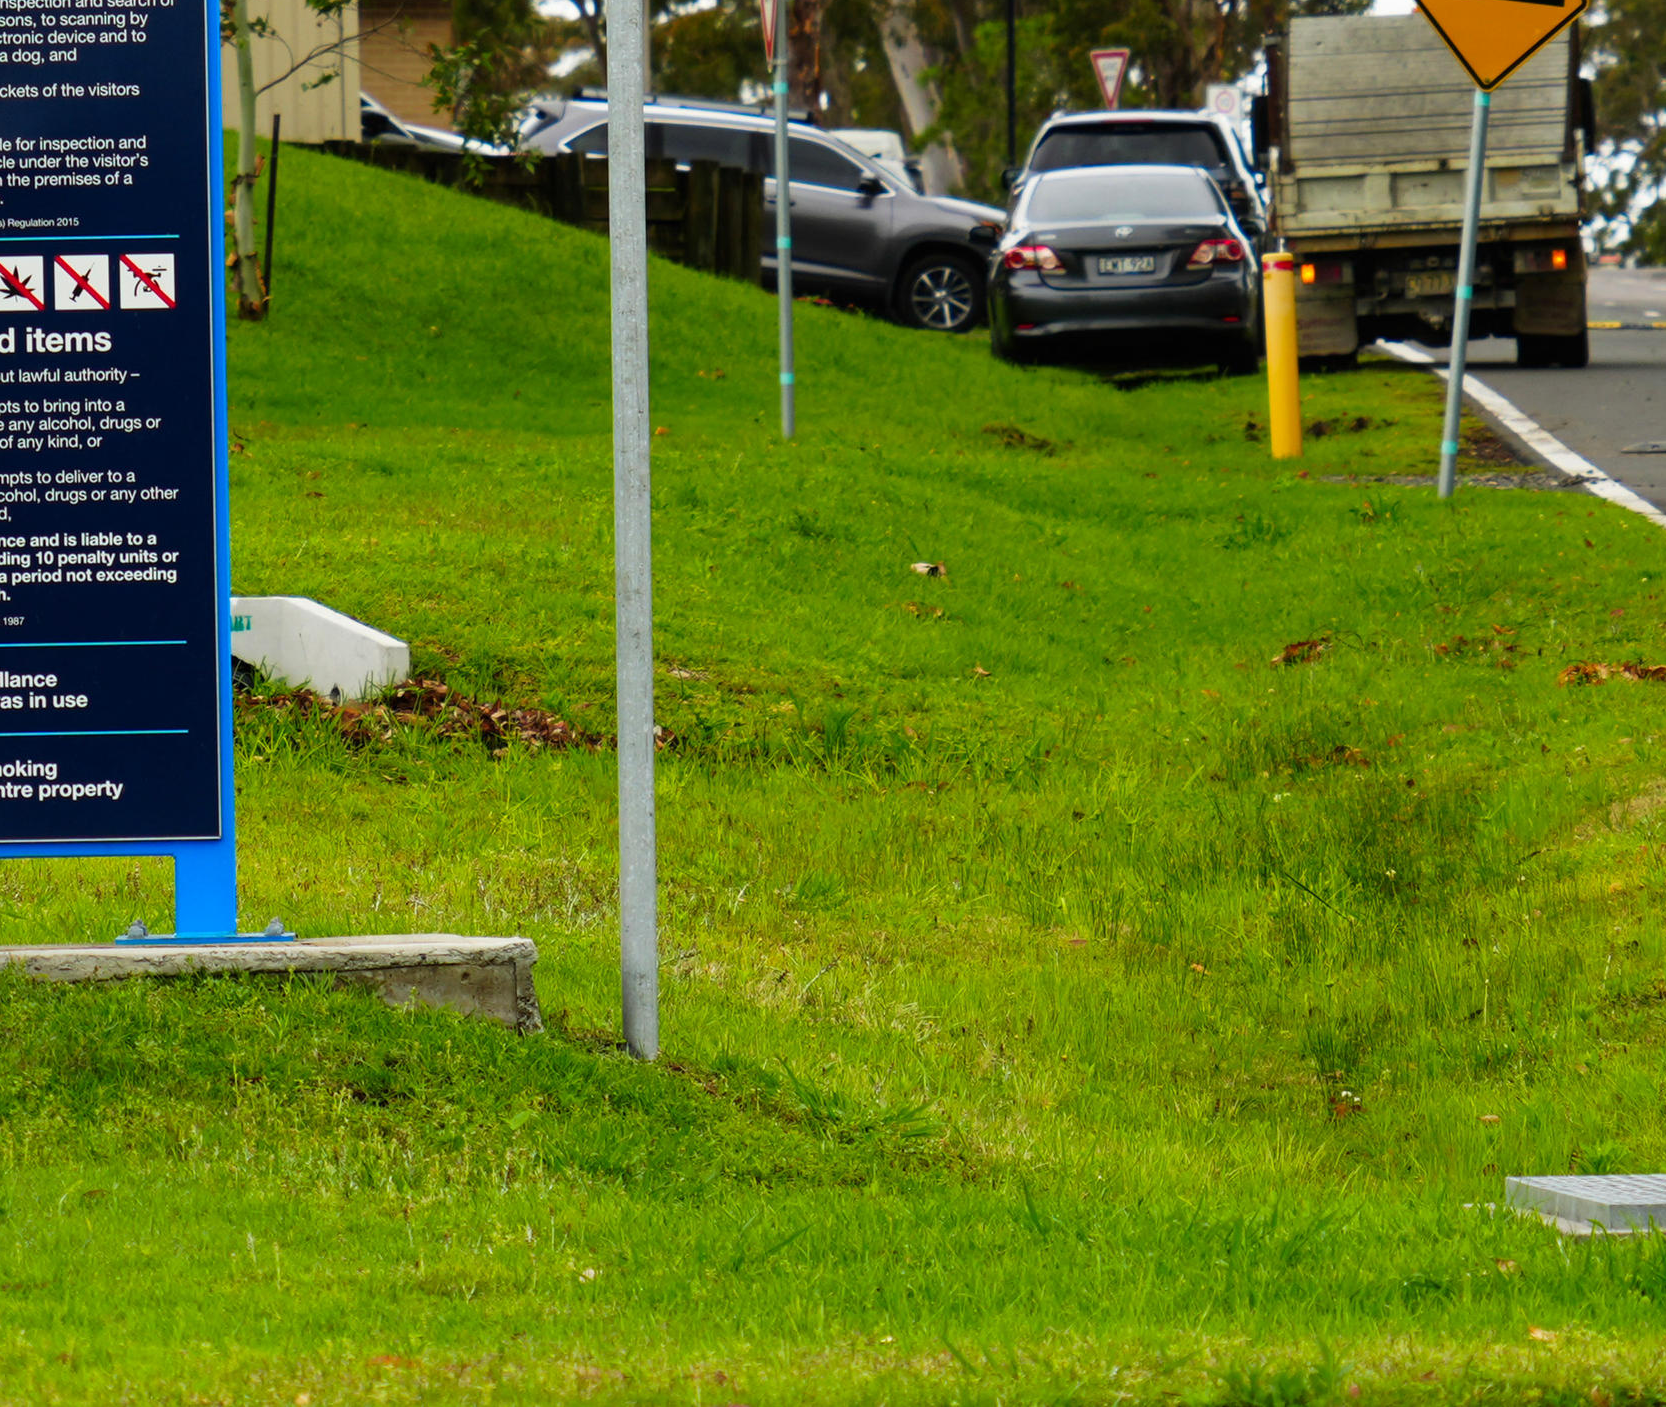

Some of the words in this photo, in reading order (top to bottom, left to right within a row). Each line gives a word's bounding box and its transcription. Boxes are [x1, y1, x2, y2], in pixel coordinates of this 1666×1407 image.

[7, 217, 54, 229] Regulation
[56, 217, 79, 226] 2015
[26, 326, 112, 352] items
[29, 691, 46, 708] in
[52, 694, 88, 708] use
[38, 777, 123, 801] property
